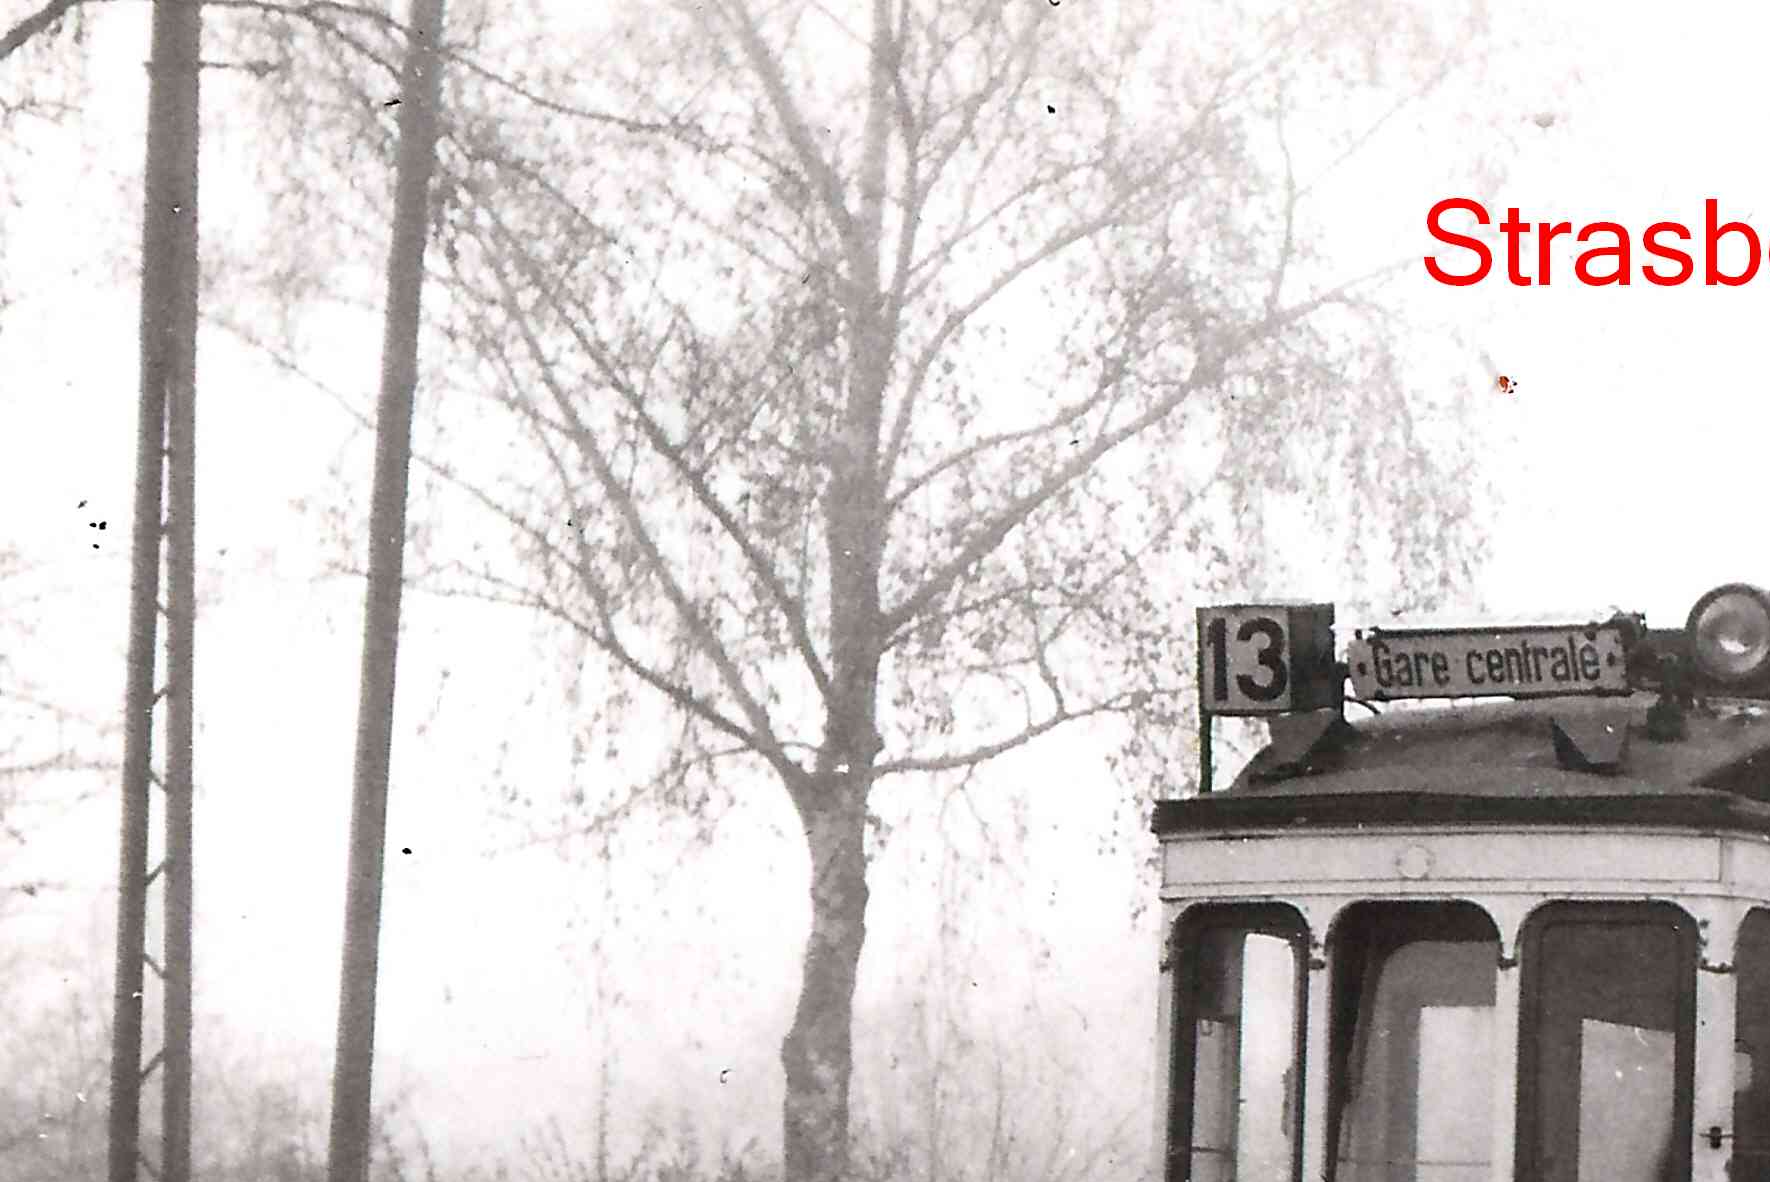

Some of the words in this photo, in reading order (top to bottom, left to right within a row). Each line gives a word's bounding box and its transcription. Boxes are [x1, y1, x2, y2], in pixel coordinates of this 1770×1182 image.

[1206, 616, 1290, 702] 13
[1372, 640, 1451, 688] Gare
[1466, 632, 1600, 685] centrale
